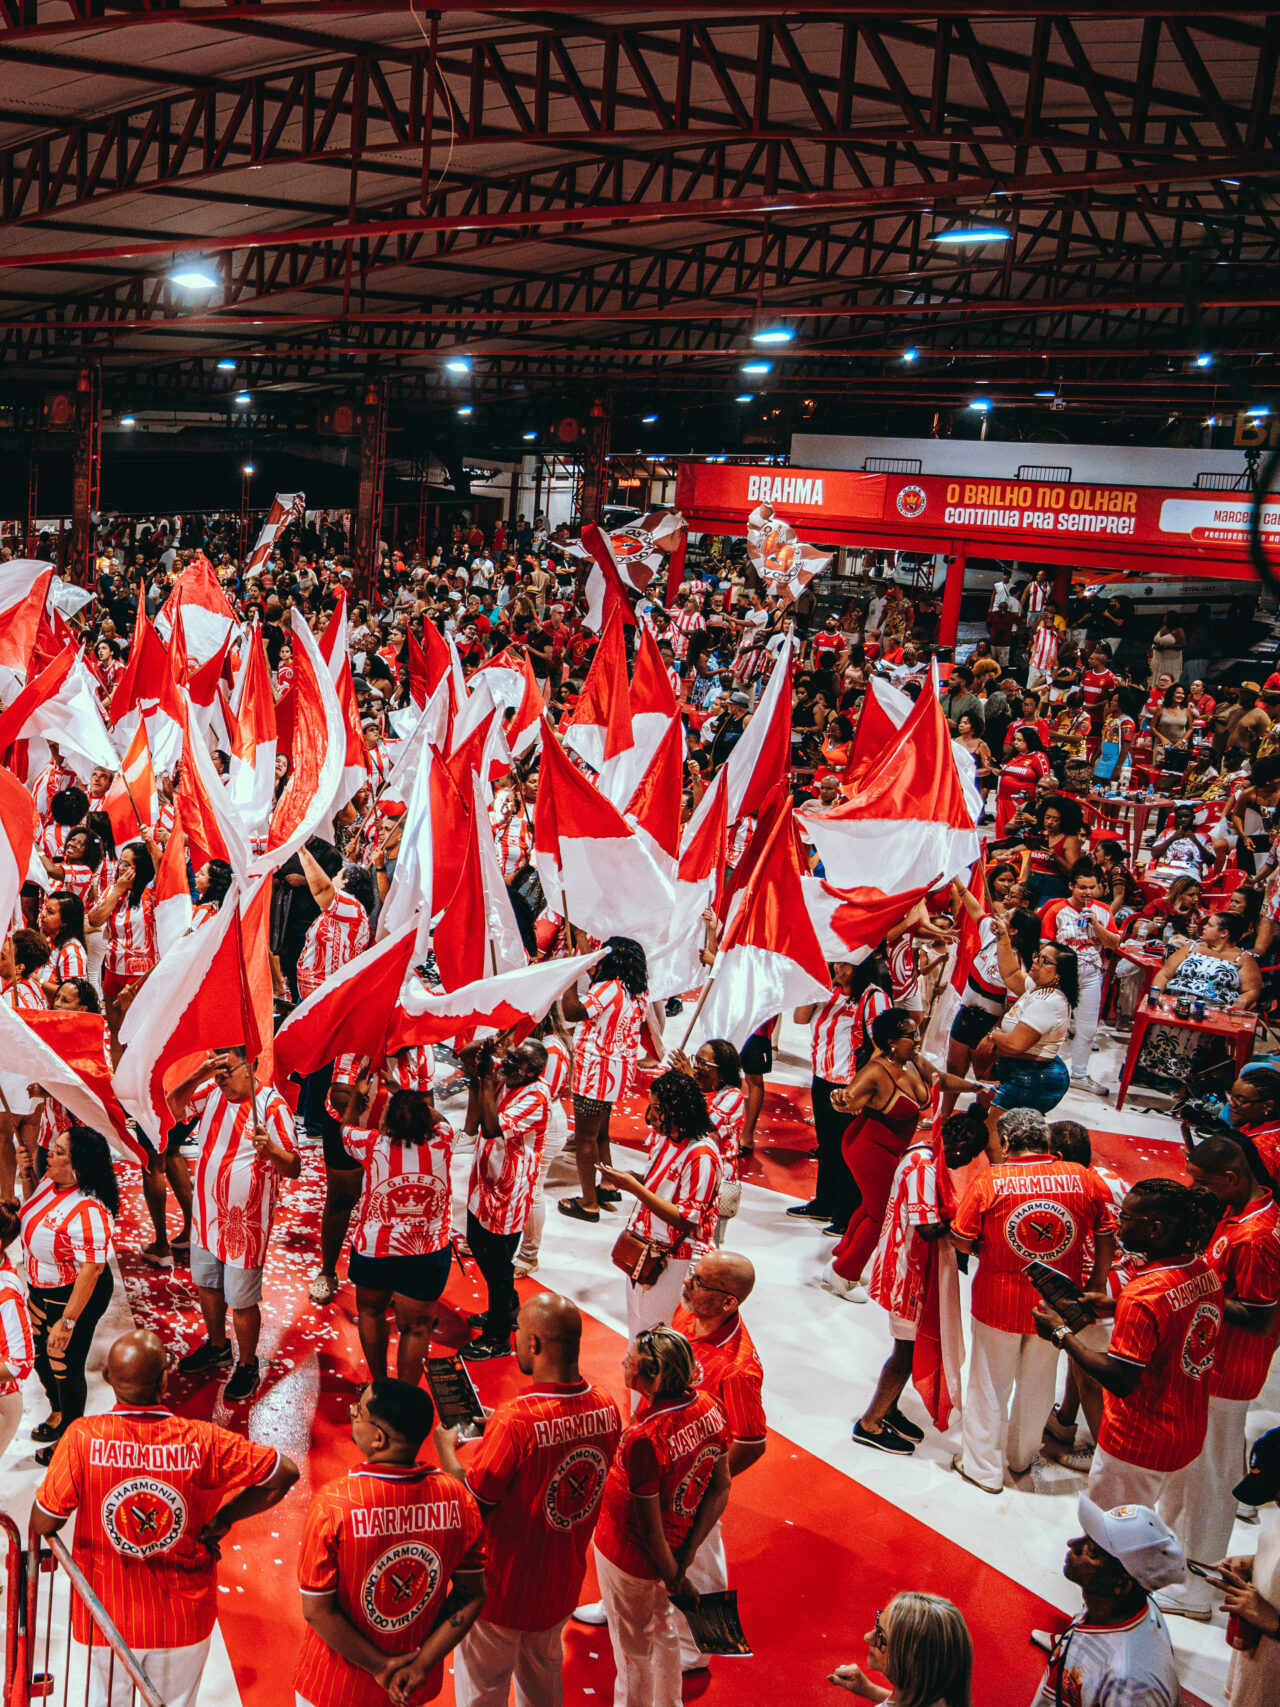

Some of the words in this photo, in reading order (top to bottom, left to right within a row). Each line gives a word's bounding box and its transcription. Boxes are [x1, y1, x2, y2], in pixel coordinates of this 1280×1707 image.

[747, 475, 823, 505] BRAHMA
[946, 484, 960, 504] O
[963, 484, 1033, 508] BRILHO
[993, 1174, 1083, 1194] HARMONIA
[1015, 1203, 1066, 1219] HARMONIA
[1022, 1249, 1037, 1260] DO
[534, 1405, 619, 1447] HARMONIA
[90, 1439, 200, 1471] HARMONIA
[114, 1482, 177, 1505] HARMONIA
[104, 1503, 122, 1546] UNIDOS
[122, 1543, 140, 1556] DO
[351, 1500, 461, 1538] HARMONIA
[377, 1544, 435, 1572] HARMONIA
[365, 1572, 379, 1619] UNIDOS
[373, 1616, 390, 1630] DO
[391, 1568, 437, 1629] VIRADOURO
